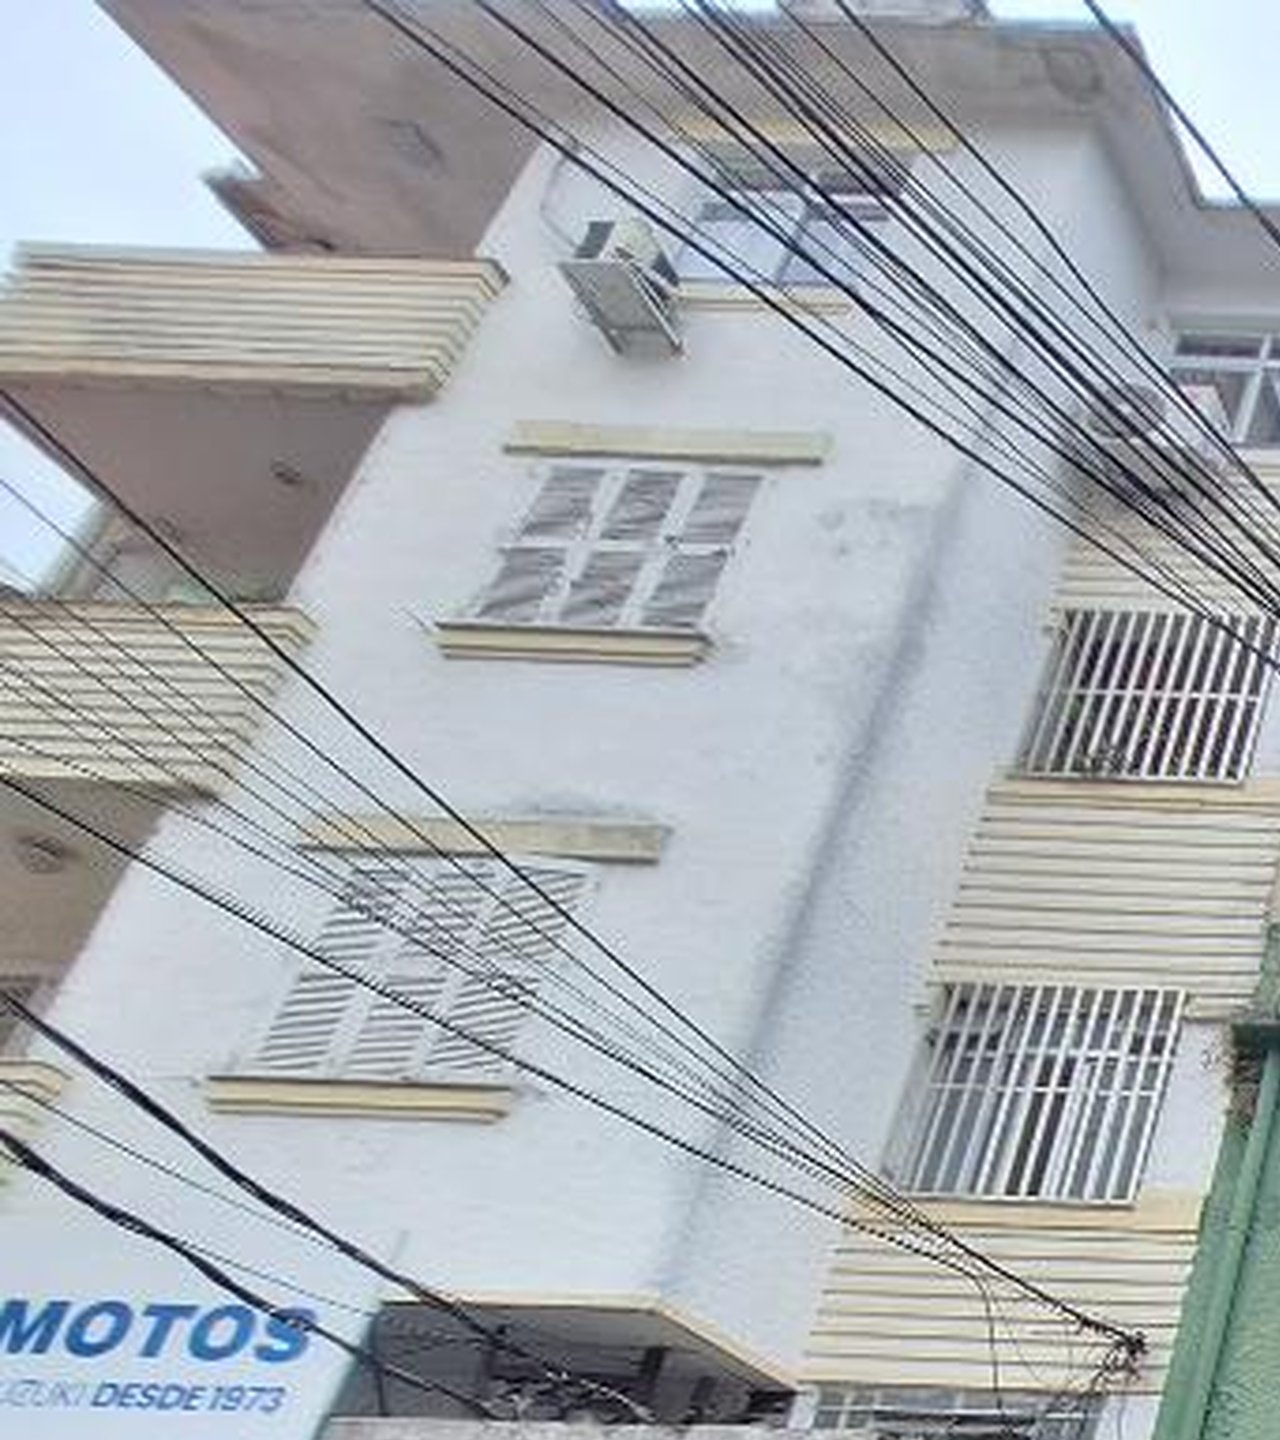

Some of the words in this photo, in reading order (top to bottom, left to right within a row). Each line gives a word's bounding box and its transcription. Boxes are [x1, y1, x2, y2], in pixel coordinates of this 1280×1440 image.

[0, 1299, 316, 1362] MOTOS
[91, 1382, 206, 1412] DESDE
[207, 1385, 286, 1414] 1973
